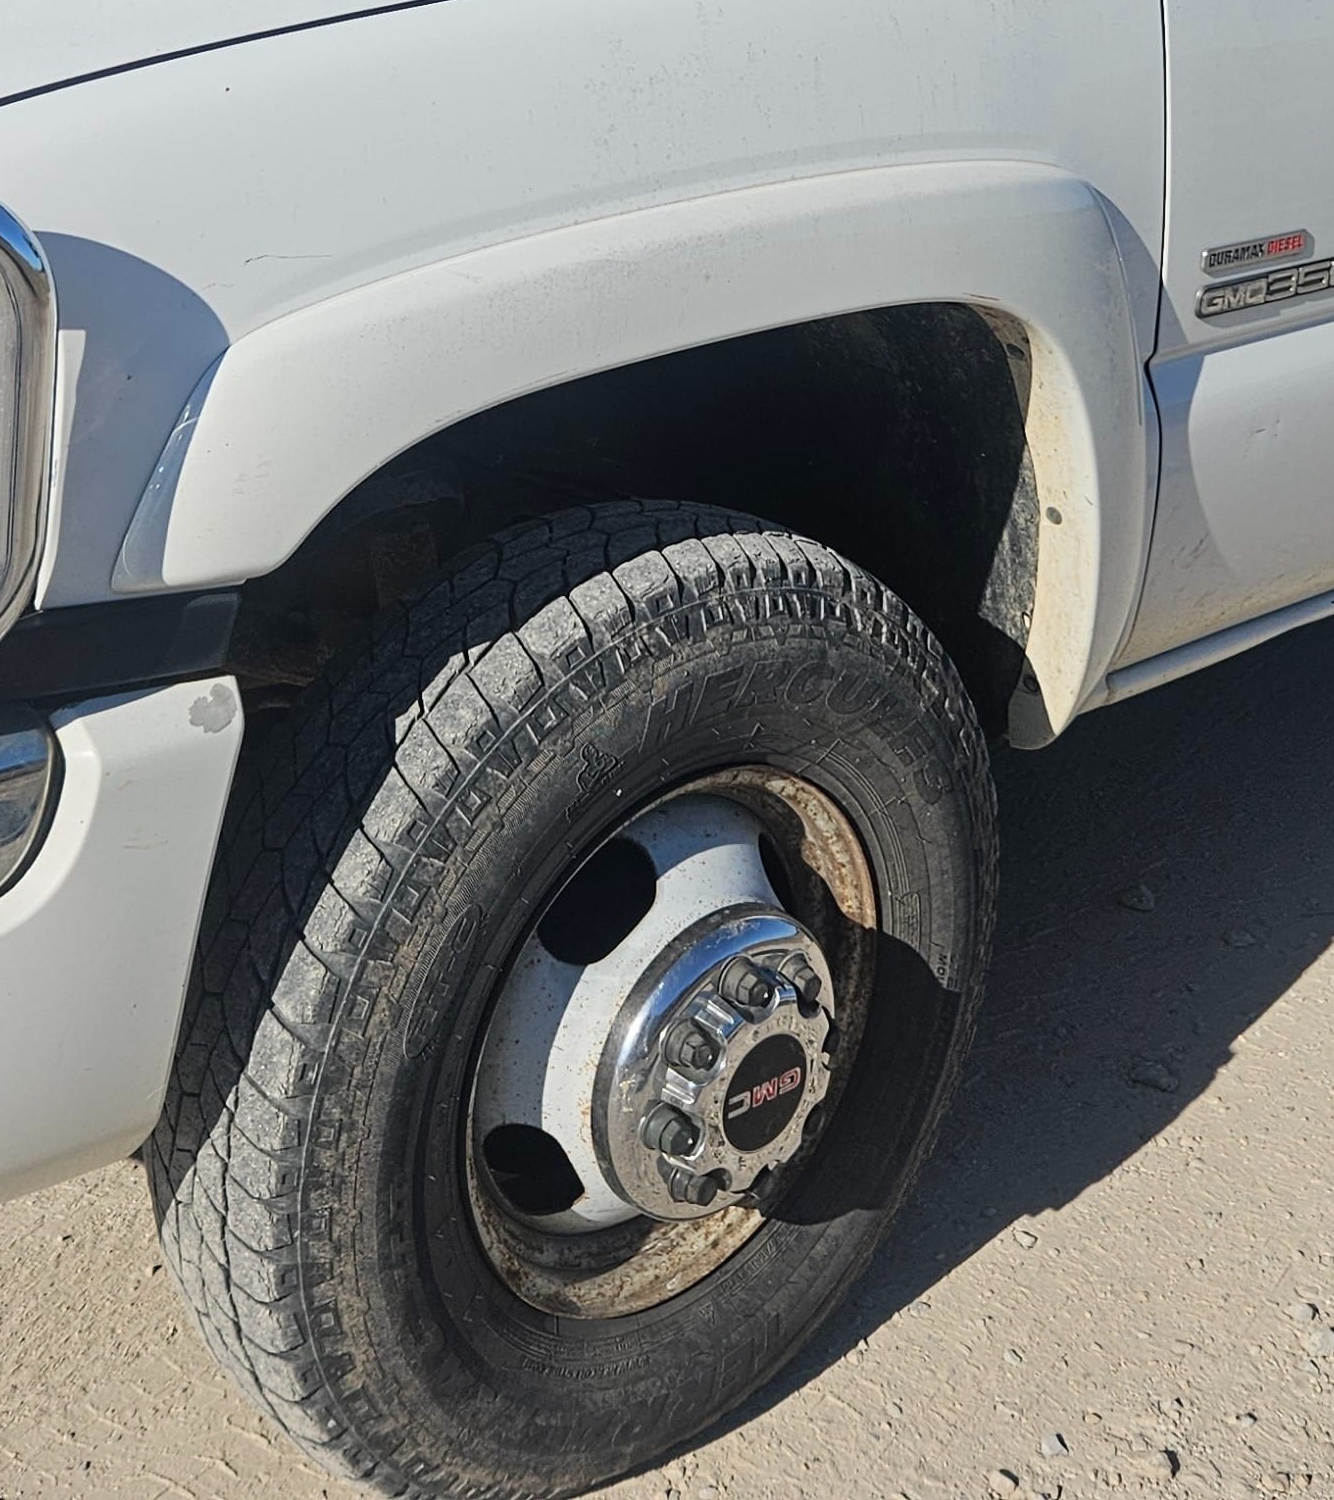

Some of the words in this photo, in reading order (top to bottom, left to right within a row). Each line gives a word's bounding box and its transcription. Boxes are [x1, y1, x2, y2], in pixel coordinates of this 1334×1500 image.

[1208, 242, 1266, 268] DURAMAX
[1267, 234, 1306, 255] DIESEL
[727, 1066, 801, 1120] GMC
